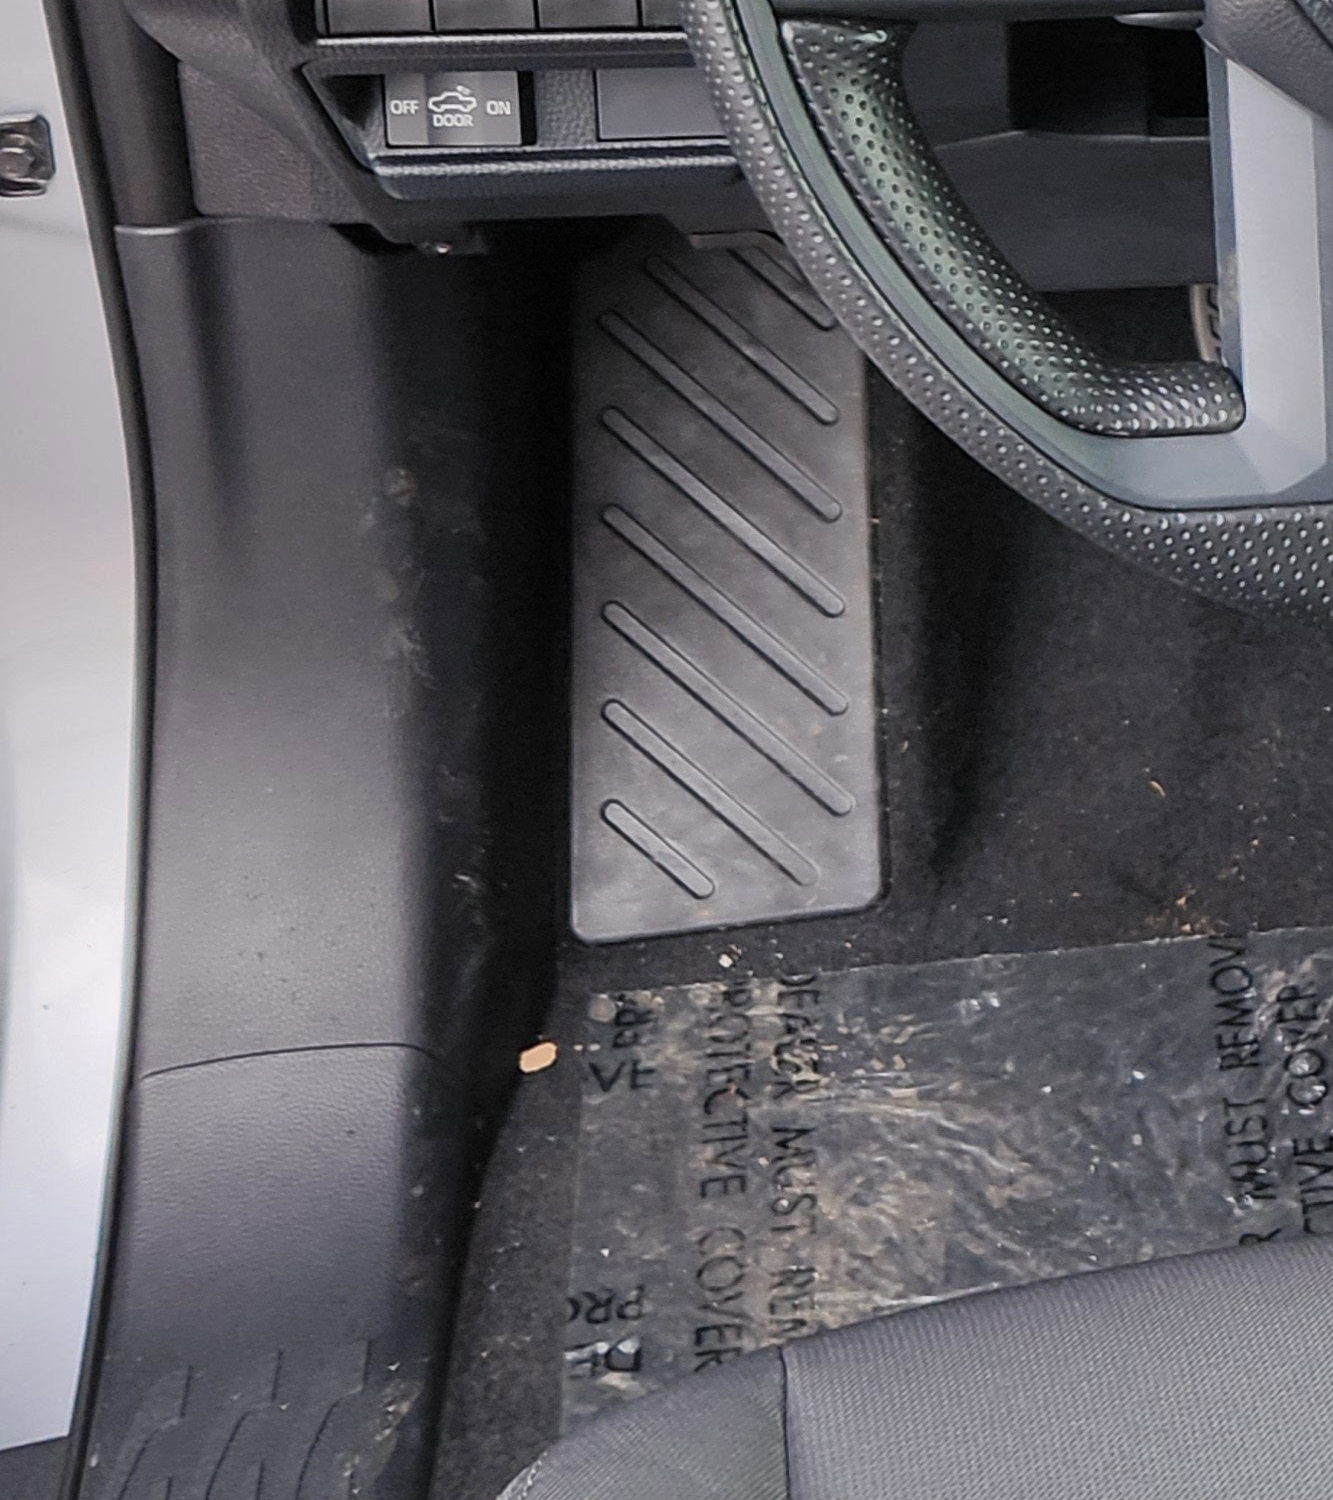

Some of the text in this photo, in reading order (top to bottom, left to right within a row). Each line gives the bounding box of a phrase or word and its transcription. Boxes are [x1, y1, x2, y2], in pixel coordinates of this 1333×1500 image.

[390, 100, 420, 116] OFF
[485, 100, 512, 116] ON
[432, 113, 476, 128] DOOR
[1206, 933, 1262, 1073] REMOV
[701, 980, 752, 1200] ROTECTIVE
